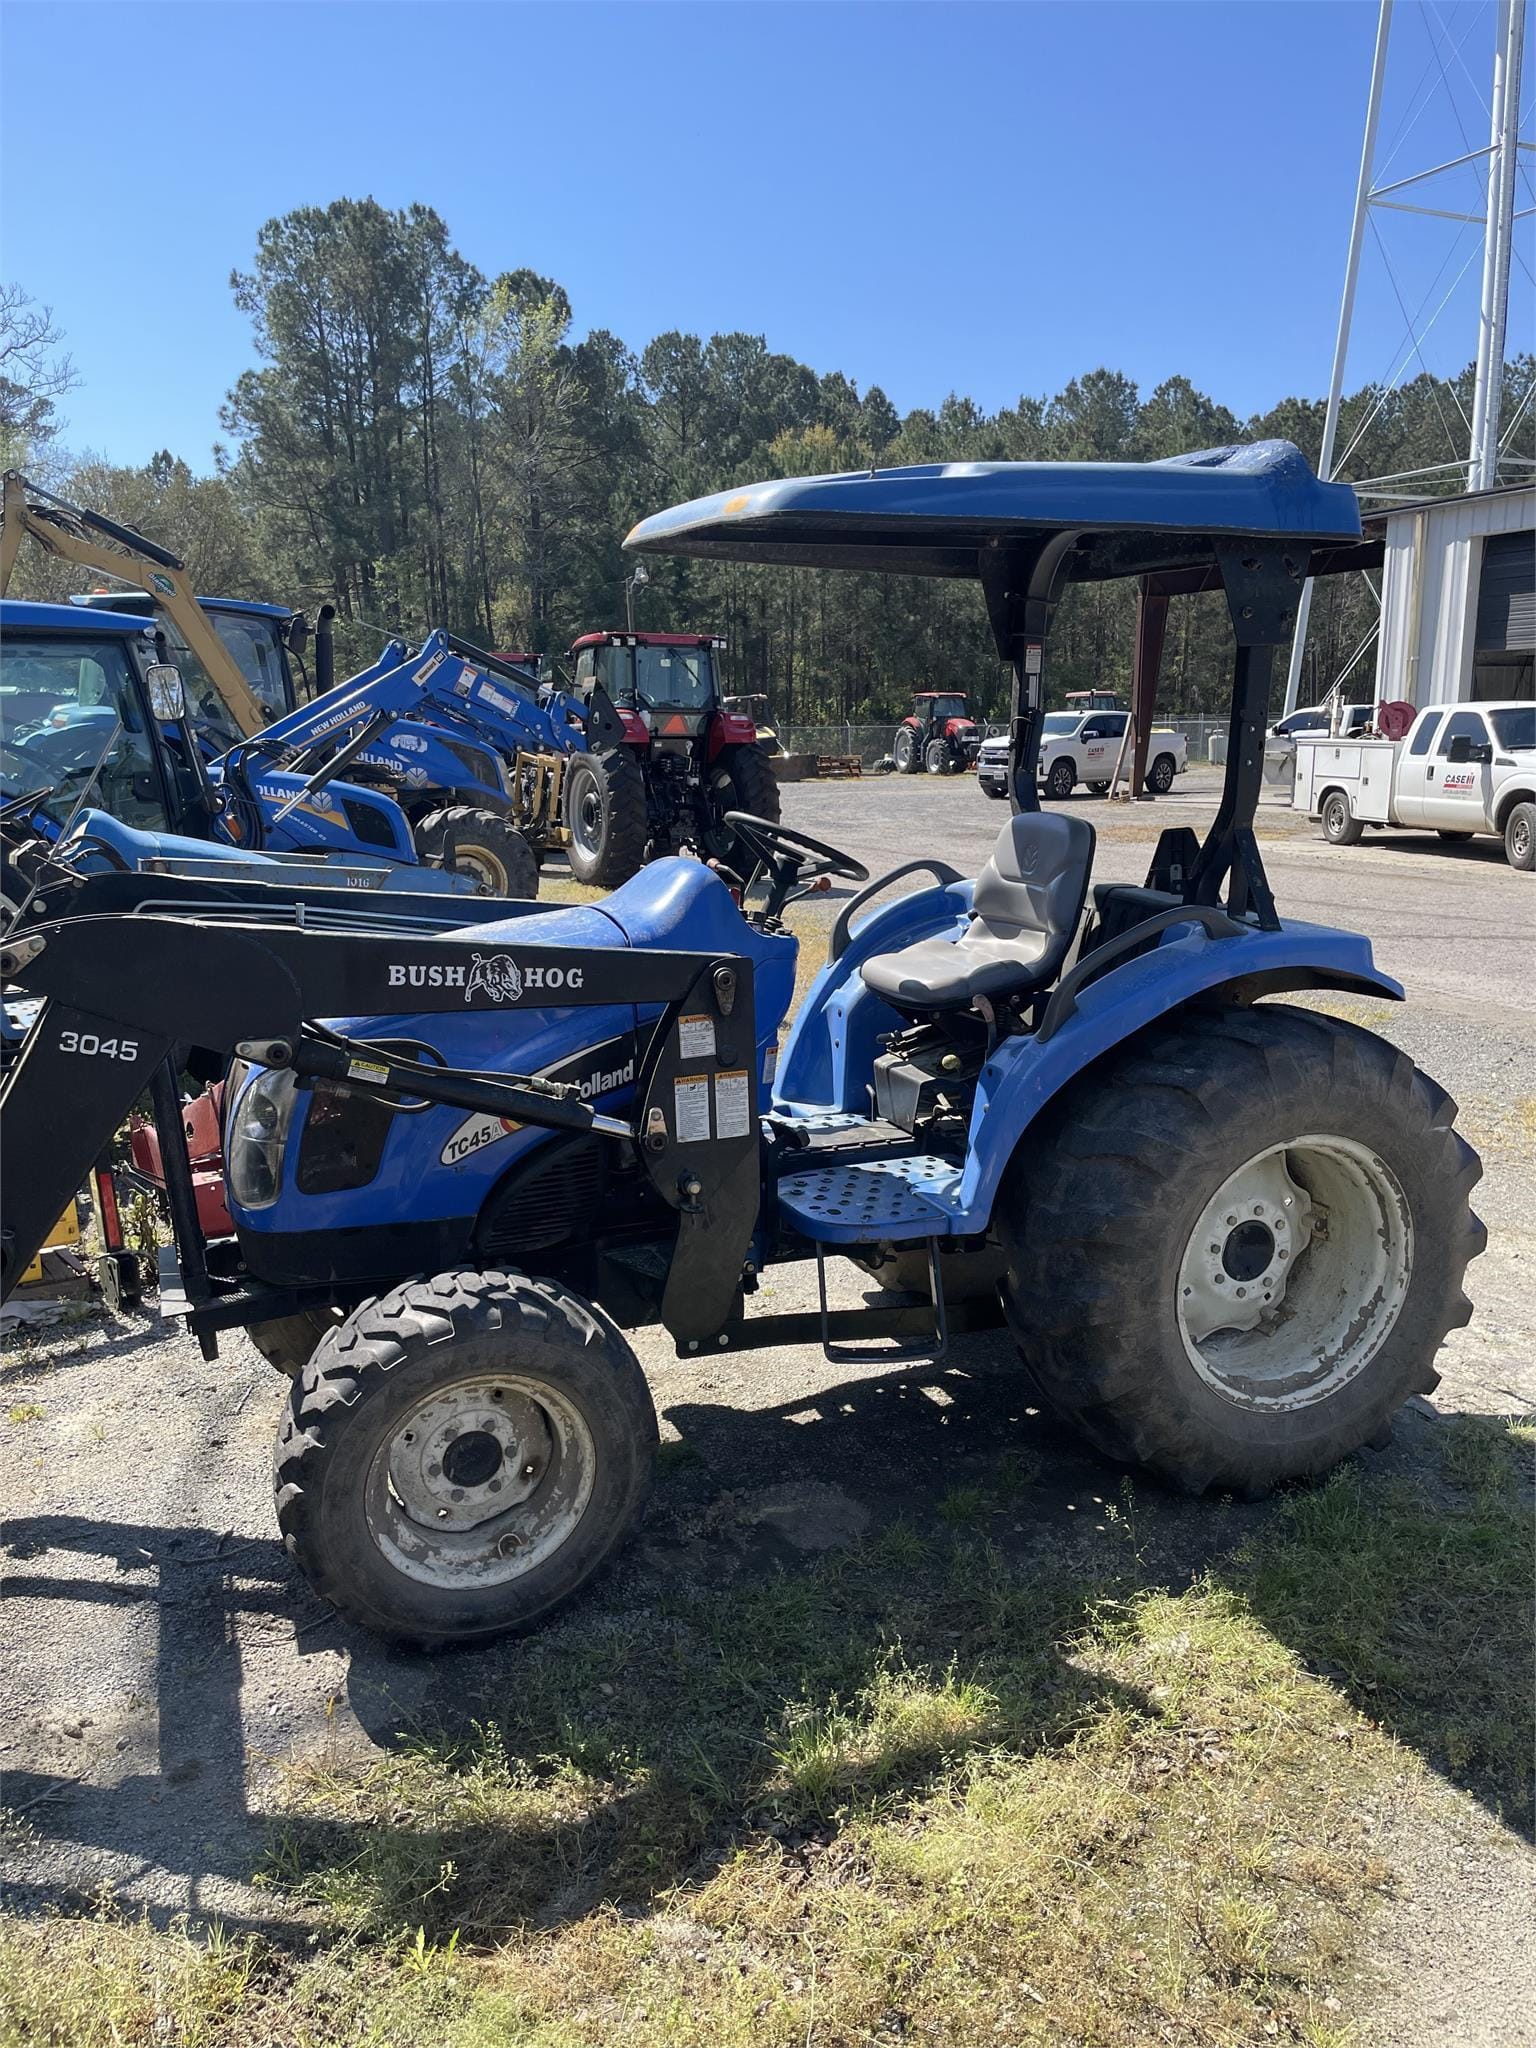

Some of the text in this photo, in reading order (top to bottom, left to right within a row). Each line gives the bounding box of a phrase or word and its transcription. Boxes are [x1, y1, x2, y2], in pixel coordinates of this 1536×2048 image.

[311, 701, 366, 736] NEW HOLLAND
[356, 751, 403, 772] OLLAND
[1446, 775, 1466, 784] CASE
[347, 877, 370, 888] 1016
[388, 965, 584, 988] BUSH HOG
[59, 1031, 139, 1062] 3045
[448, 1123, 504, 1161] TC45A
